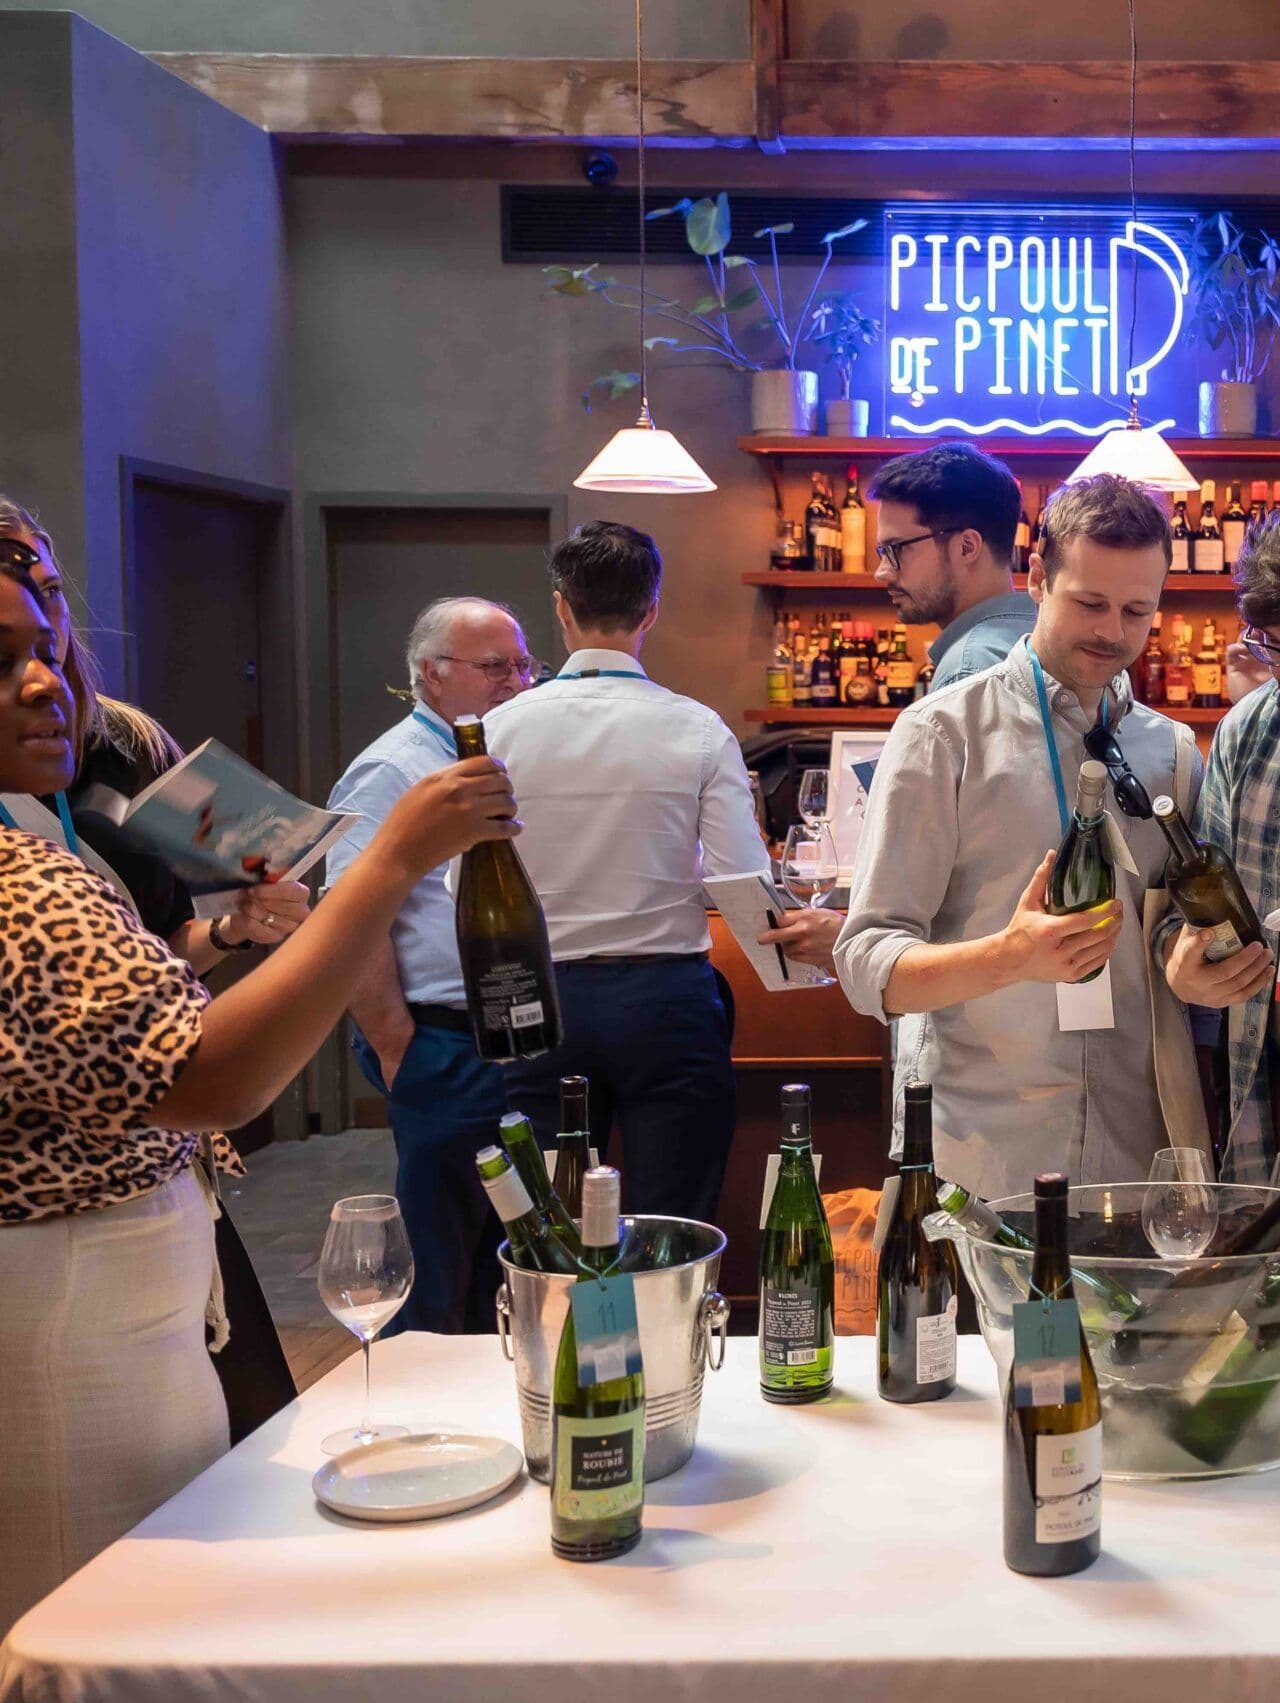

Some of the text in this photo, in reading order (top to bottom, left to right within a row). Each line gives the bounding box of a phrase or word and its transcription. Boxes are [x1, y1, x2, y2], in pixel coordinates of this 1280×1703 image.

[890, 234, 1110, 314] PICPOUL
[890, 316, 1110, 398] DE PINET
